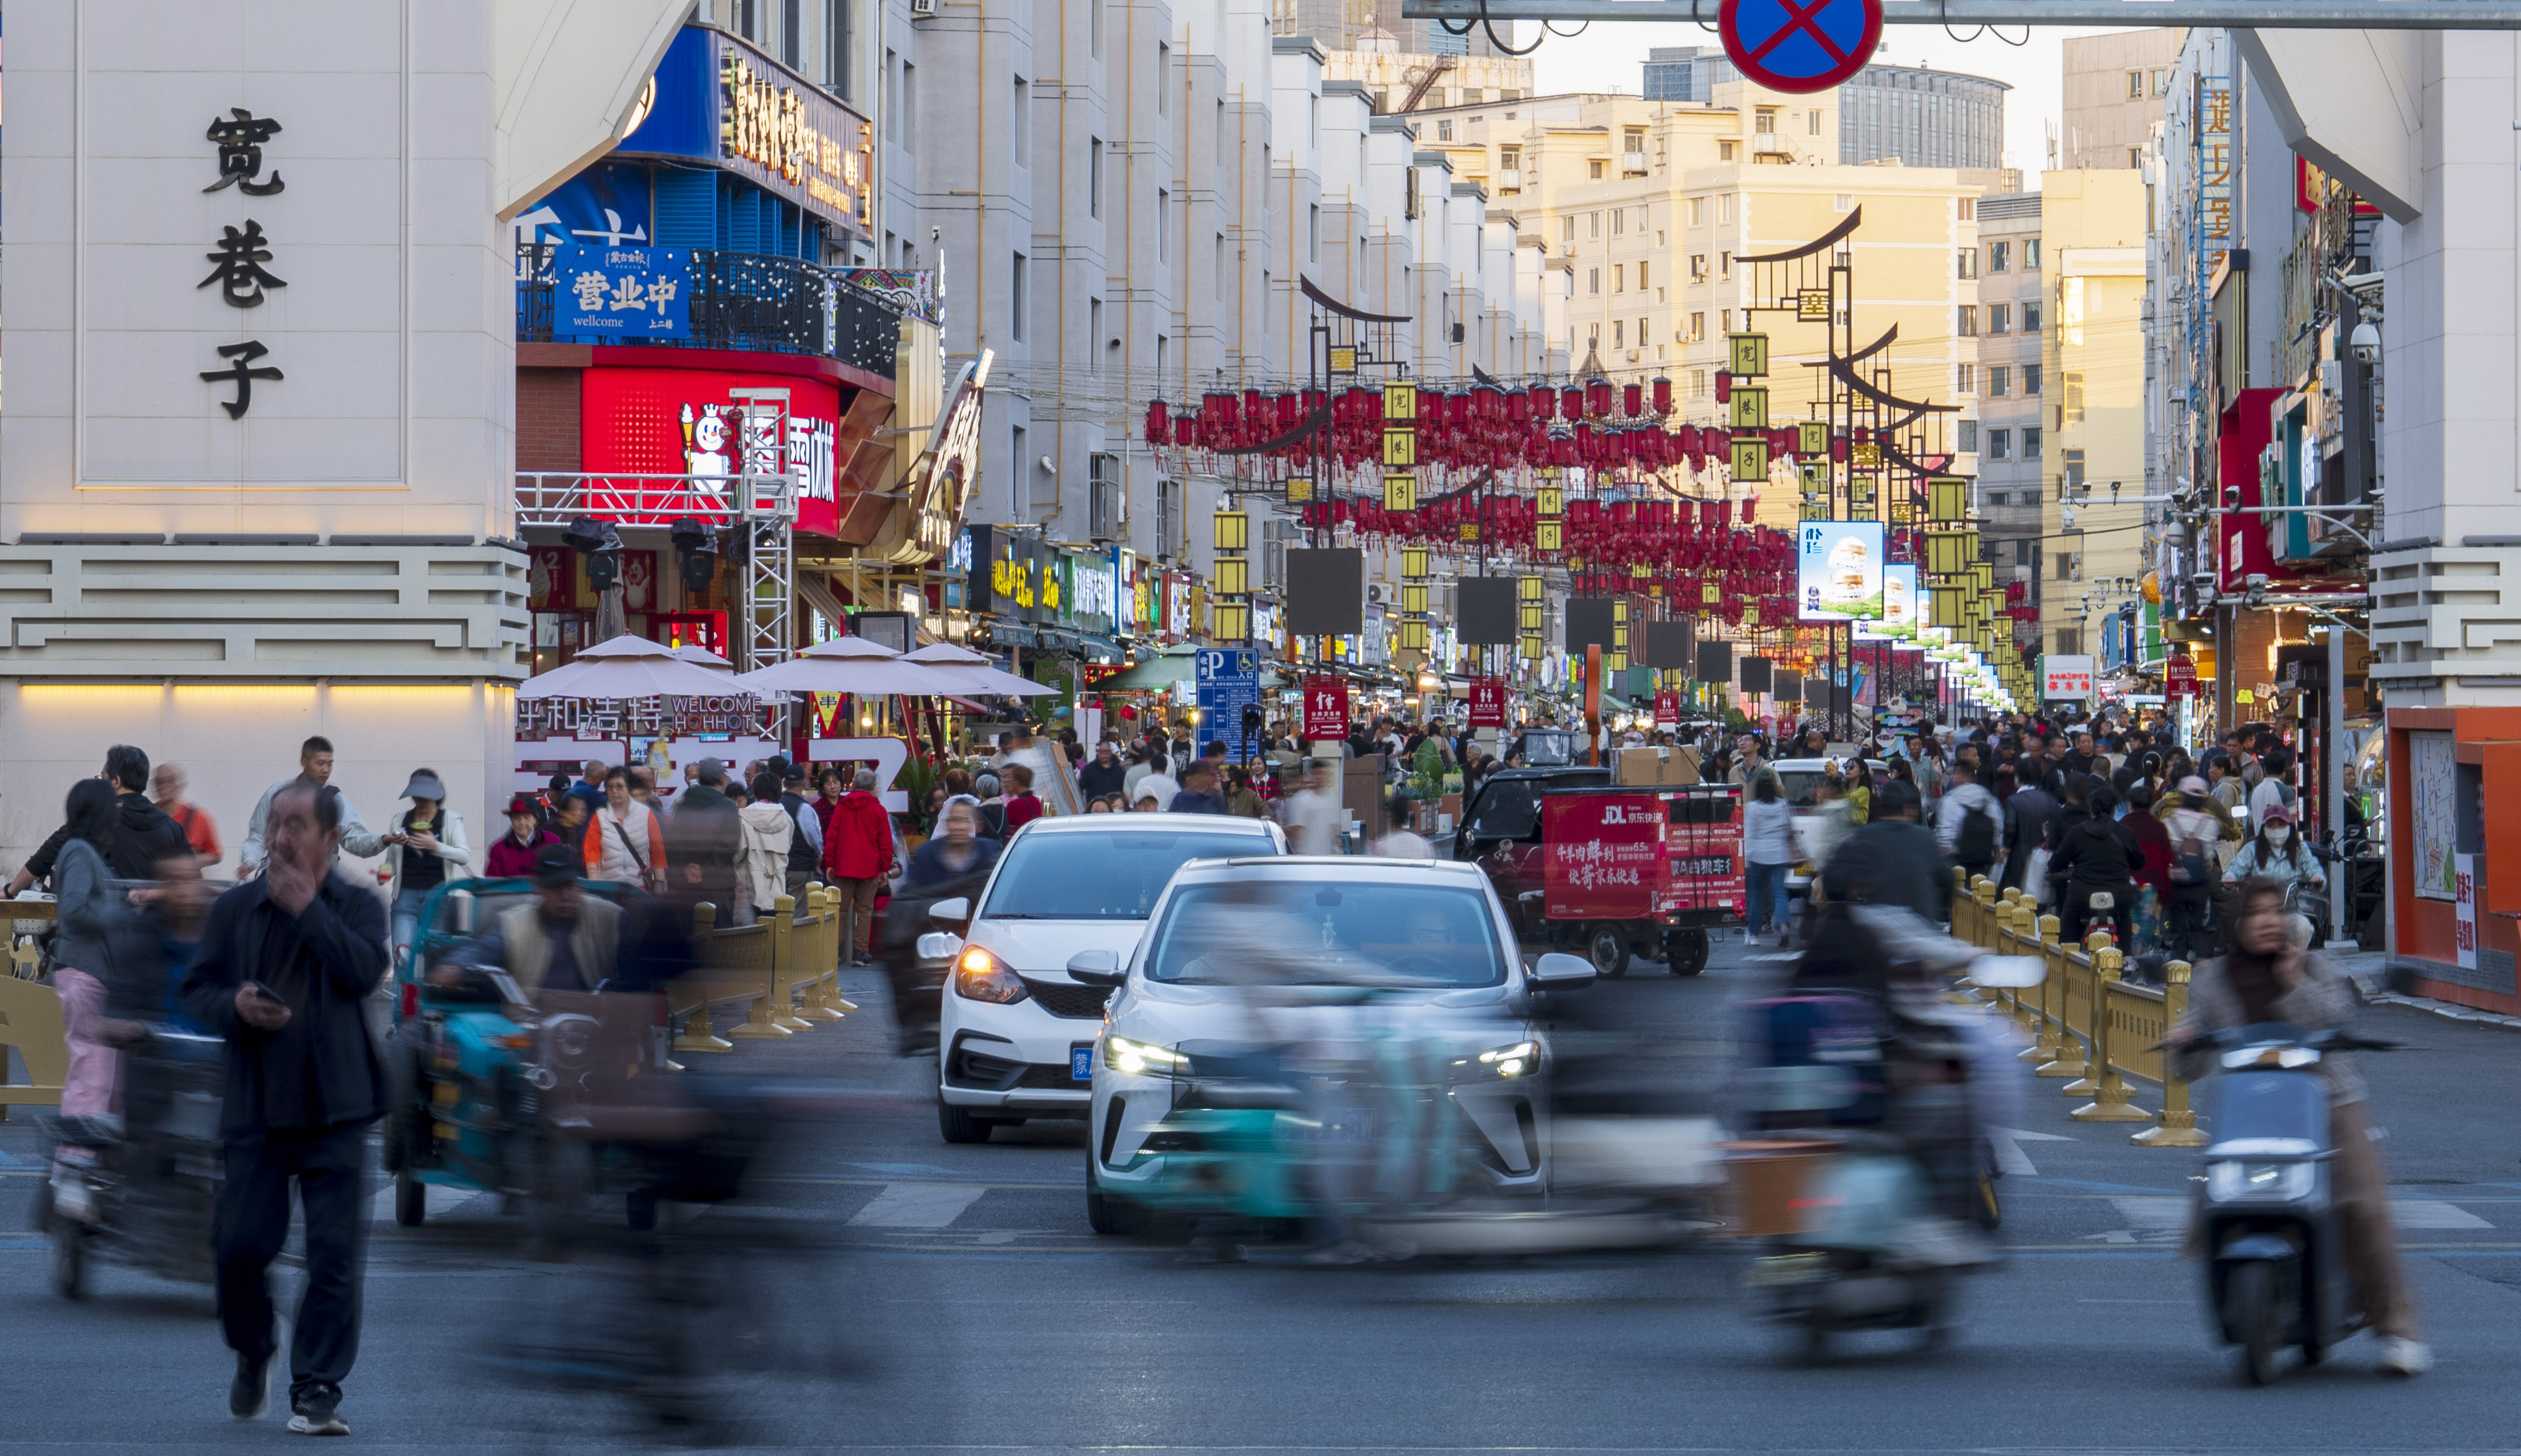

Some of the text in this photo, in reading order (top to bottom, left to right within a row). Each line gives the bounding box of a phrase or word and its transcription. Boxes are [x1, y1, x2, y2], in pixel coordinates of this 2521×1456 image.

[197, 107, 288, 420] 宽巷子
[611, 251, 645, 264] 蒙古金帐
[572, 271, 676, 316] 营业中
[573, 315, 624, 327] wellcome
[1740, 346, 1755, 467] 宽巷子
[1393, 394, 1406, 499] 宽巷子
[1200, 657, 1208, 676] 收费
[1207, 652, 1225, 680] P
[1238, 672, 1253, 680] 入口
[672, 696, 762, 712] WELCOME
[819, 694, 837, 708] 串
[512, 696, 663, 731] 呼和浩特
[675, 714, 752, 730] HOHHOT
[1601, 806, 1627, 824] JDL
[1628, 812, 1663, 824] 京东快递
[1557, 838, 1614, 866] 牛羊肉鲜到
[1569, 863, 1640, 891] 快寄京东快递
